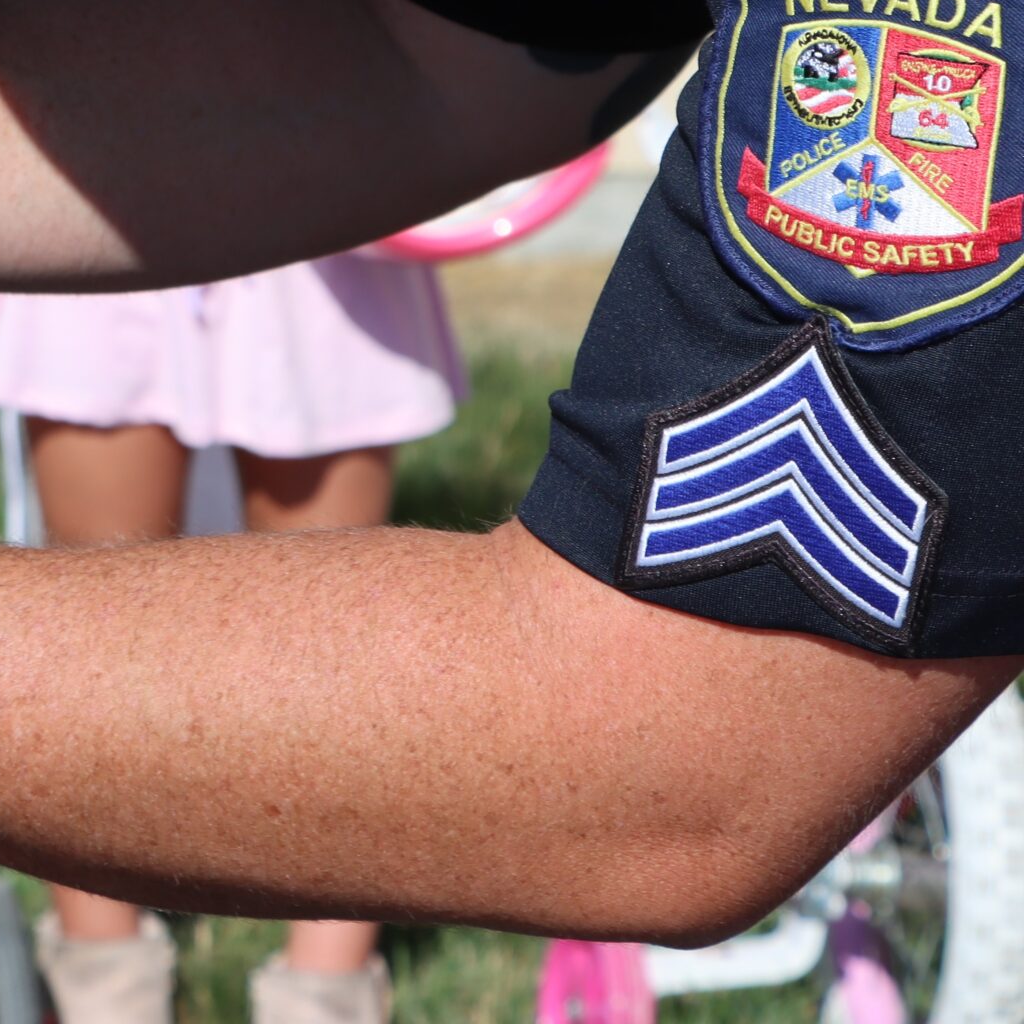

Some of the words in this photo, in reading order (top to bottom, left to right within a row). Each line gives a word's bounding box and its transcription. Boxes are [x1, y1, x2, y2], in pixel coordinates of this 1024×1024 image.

[780, 132, 847, 178] POLICE
[907, 152, 955, 195] FIRE
[845, 178, 890, 204] EMS
[764, 204, 855, 257] PUBLIC
[863, 240, 976, 269] SAFETY
